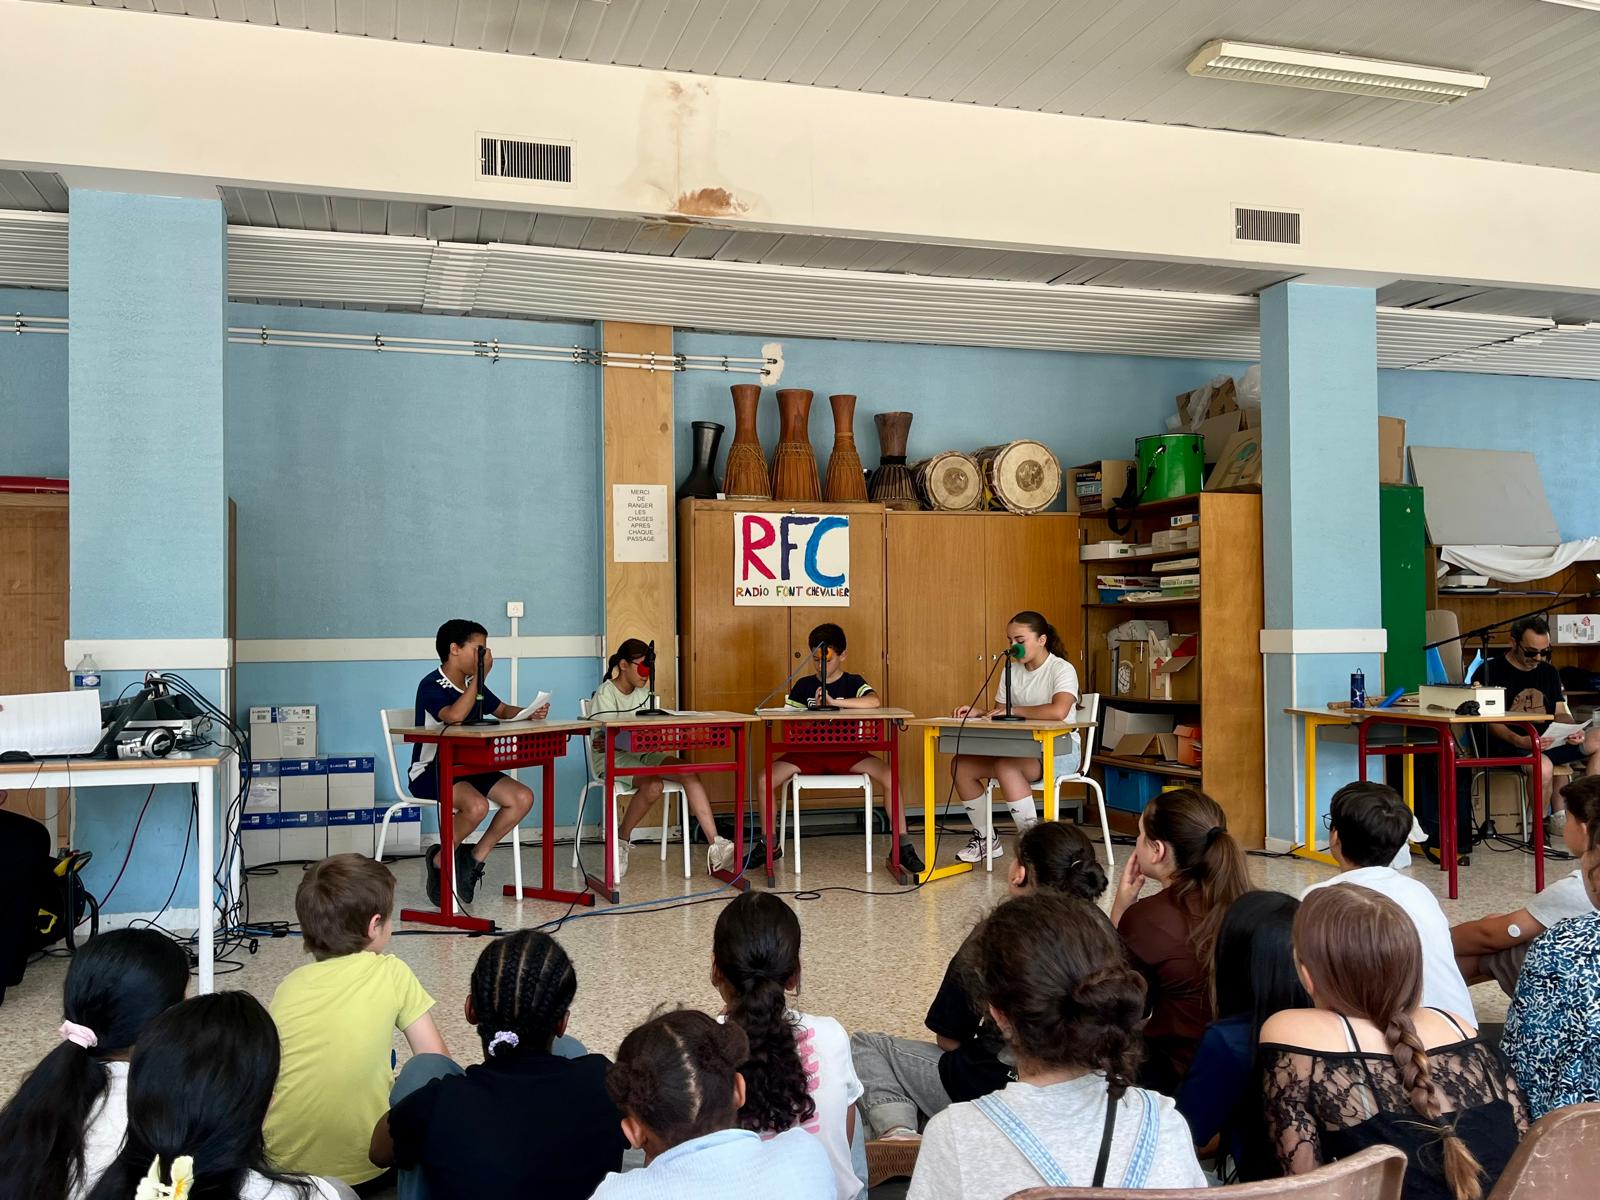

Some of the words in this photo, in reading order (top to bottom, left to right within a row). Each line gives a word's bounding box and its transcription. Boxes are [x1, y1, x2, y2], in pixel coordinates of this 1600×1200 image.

[743, 515, 849, 587] RFC
[776, 586, 803, 597] FONT
[806, 586, 849, 597] CHEVALIER
